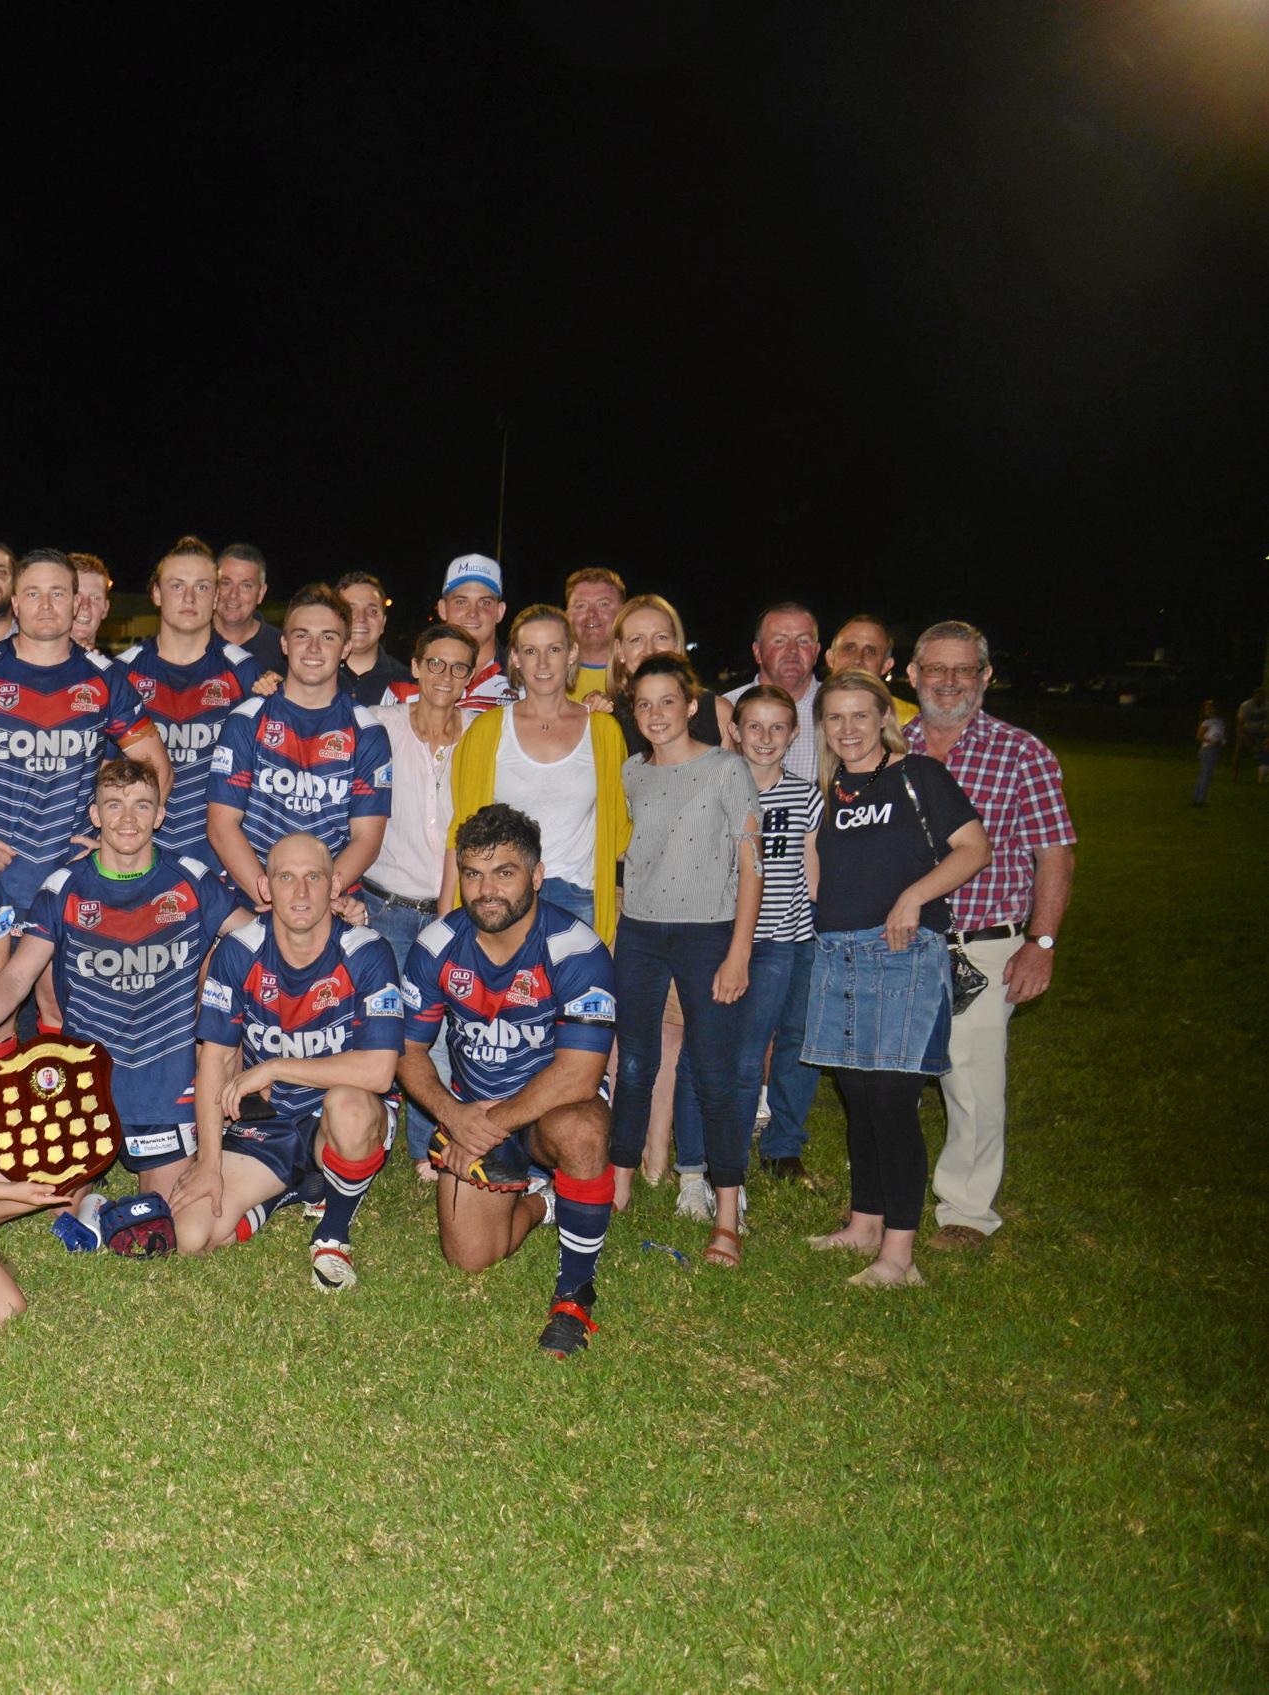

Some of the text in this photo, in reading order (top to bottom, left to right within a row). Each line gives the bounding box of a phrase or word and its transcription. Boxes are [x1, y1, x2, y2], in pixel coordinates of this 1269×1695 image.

[0, 685, 16, 693] QLD
[139, 680, 153, 688] QLD
[71, 703, 100, 712] COWBOYS
[266, 723, 281, 731] QLD
[167, 748, 198, 763] LUB
[319, 749, 351, 762] COWBOYS
[25, 756, 67, 772] CLUB
[259, 767, 349, 805] CONDY
[284, 796, 322, 812] CLUB
[835, 803, 893, 830] C&M
[117, 871, 144, 879] STEEDEN
[81, 903, 97, 911] QLD
[155, 912, 187, 924] COWBOYS
[77, 941, 189, 977] CONDY
[111, 974, 156, 991] CLUB
[452, 971, 470, 980] QLD
[506, 991, 539, 1007] COWBOYS
[247, 1023, 346, 1058] CONDY
[463, 1044, 508, 1063] CLUB
[140, 1134, 177, 1145] Warwick Ice
